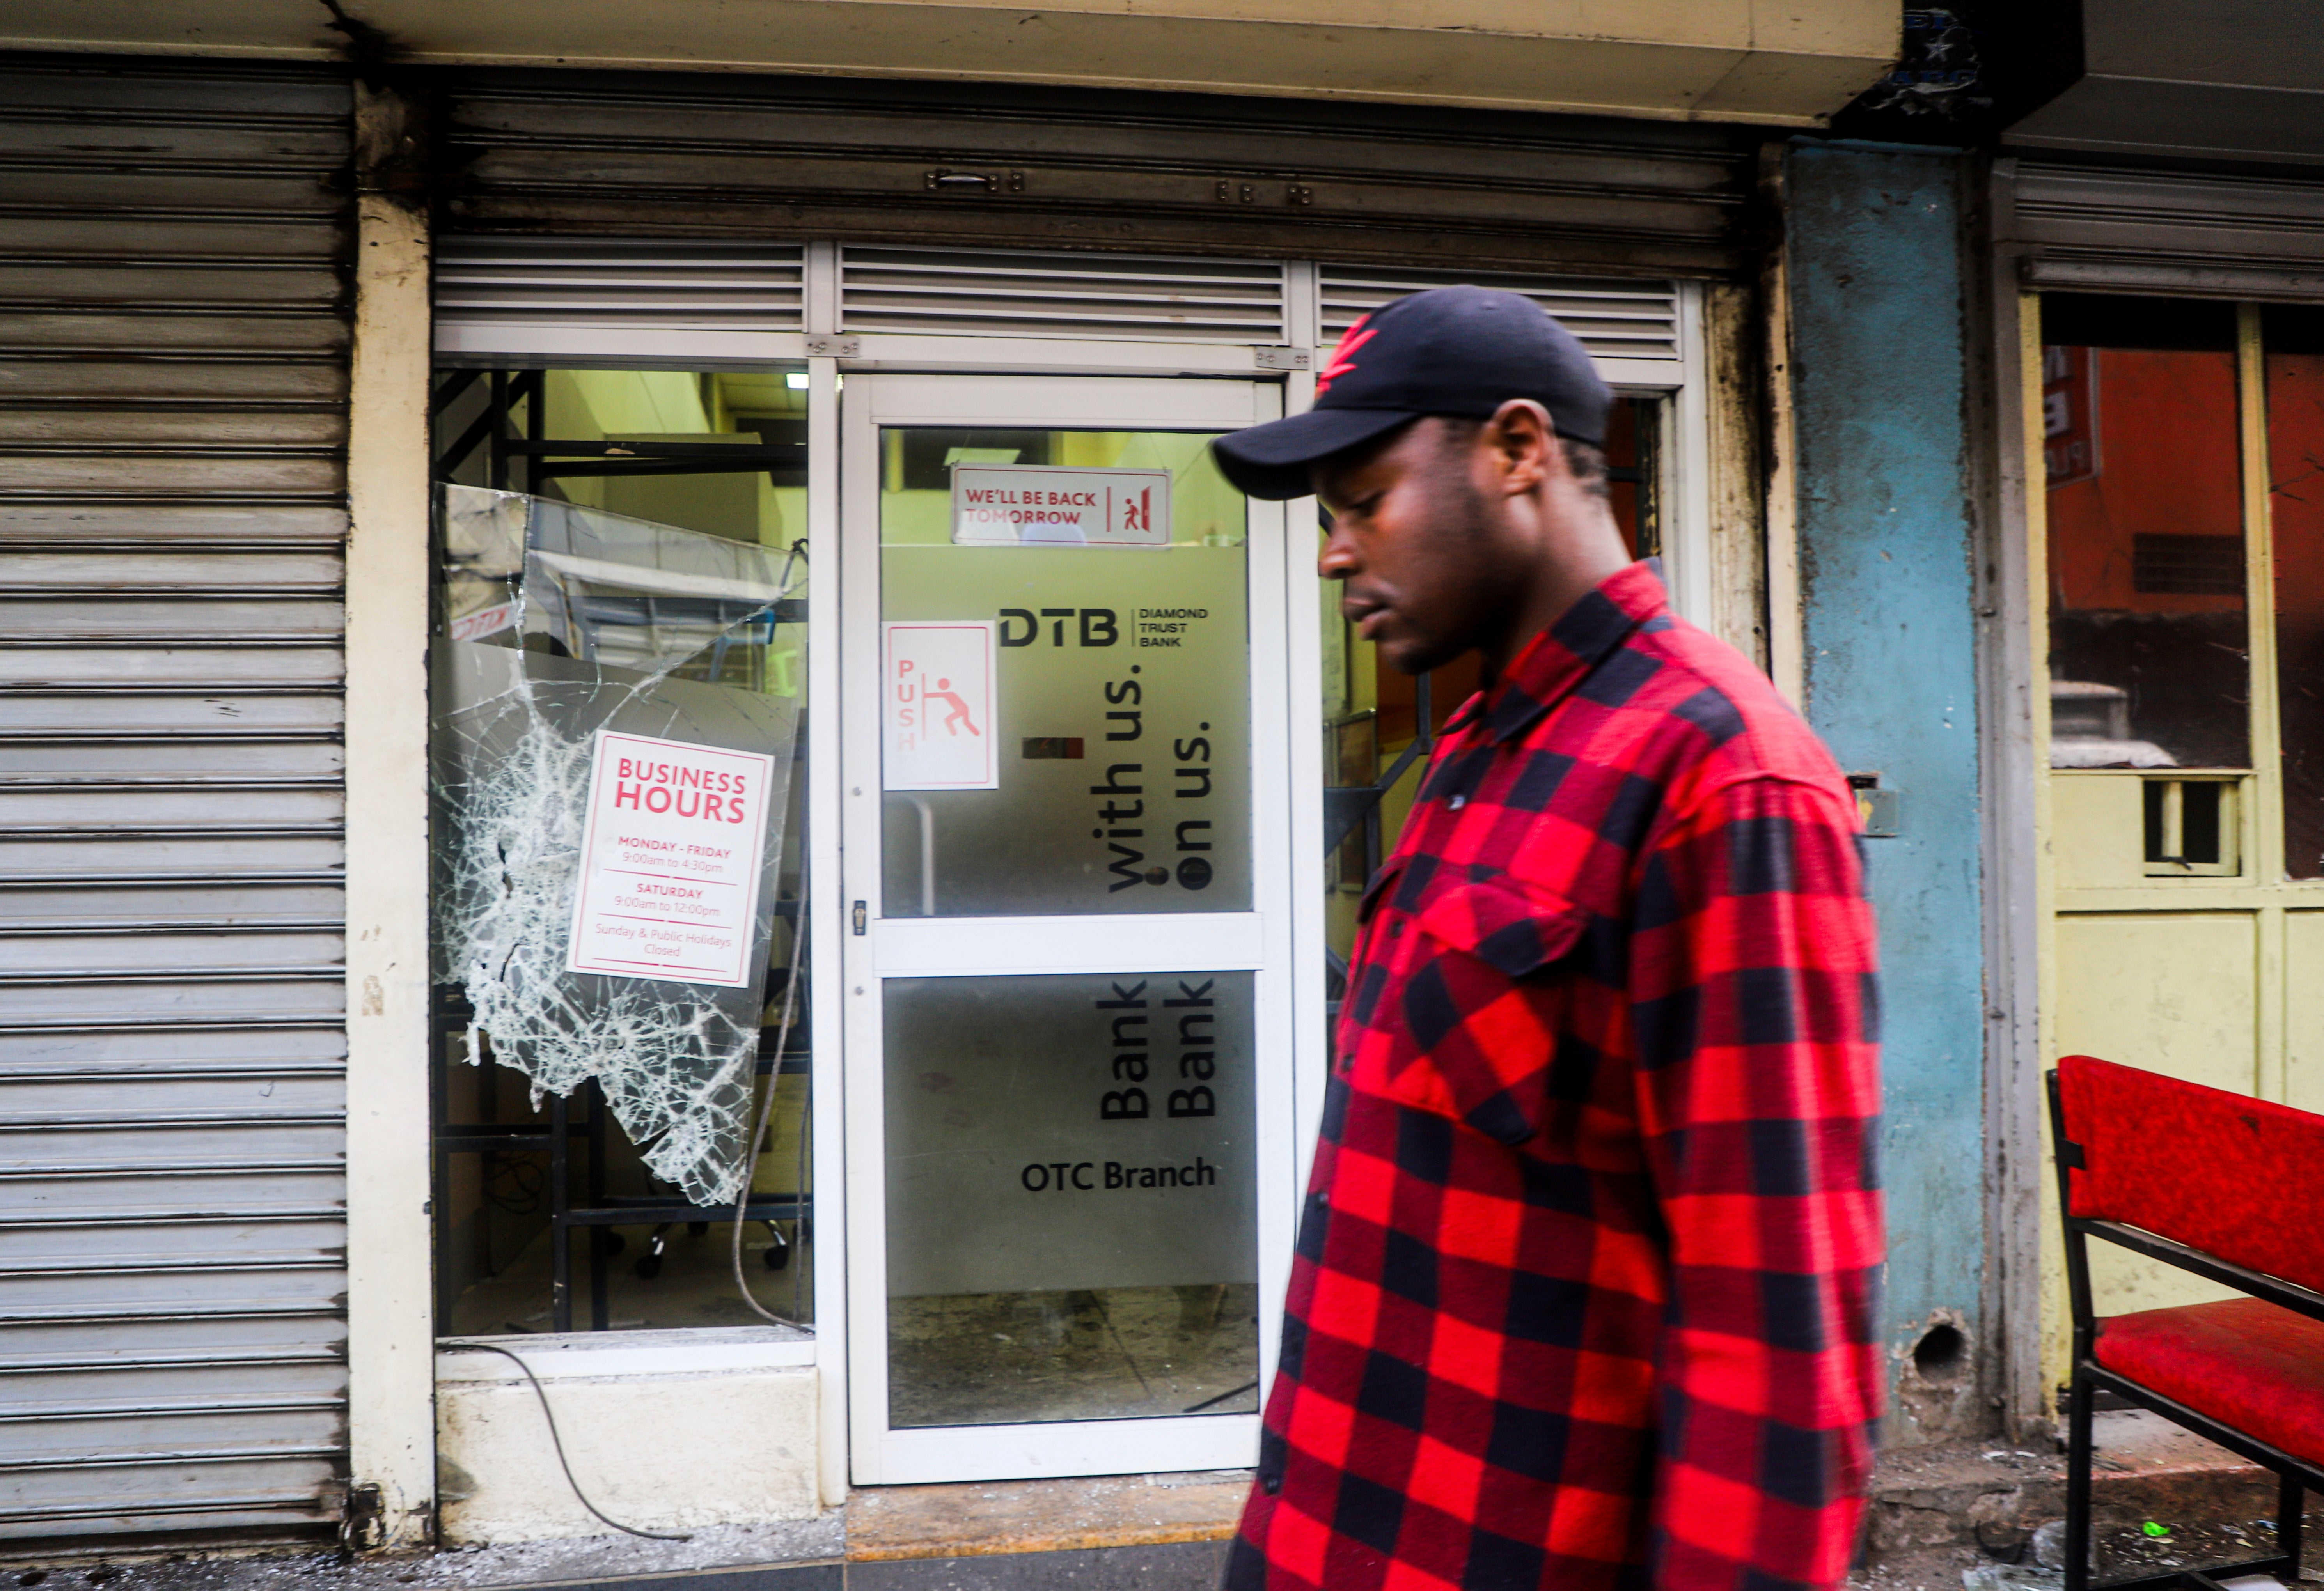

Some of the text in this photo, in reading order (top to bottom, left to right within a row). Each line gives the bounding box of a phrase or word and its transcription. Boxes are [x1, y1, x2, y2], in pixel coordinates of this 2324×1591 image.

[965, 489, 1096, 506] WE'LL BE BACK
[965, 508, 1081, 524] TOMORROW
[1140, 609, 1207, 618] DIAMOND
[1001, 609, 1118, 647] DTB
[1140, 623, 1187, 633] TRUST
[1141, 638, 1180, 647] BANK
[897, 660, 915, 751] PUSH
[617, 758, 745, 794] BUSINESS
[614, 781, 745, 824] HOURS
[618, 836, 677, 852] MONDAY
[687, 845, 731, 859] FRIDAY
[623, 852, 723, 873] 9:00am to 4:30pm
[636, 883, 704, 899] SATURDAY
[1089, 665, 1148, 1120] Bank with us.
[614, 896, 720, 917] 9:00am to 12:00pm
[1163, 722, 1215, 1118] Bank on us.
[595, 923, 731, 949] Sunday & Public Holidays
[644, 944, 681, 957] Closed
[1021, 1157, 1215, 1192] OTC Branch
